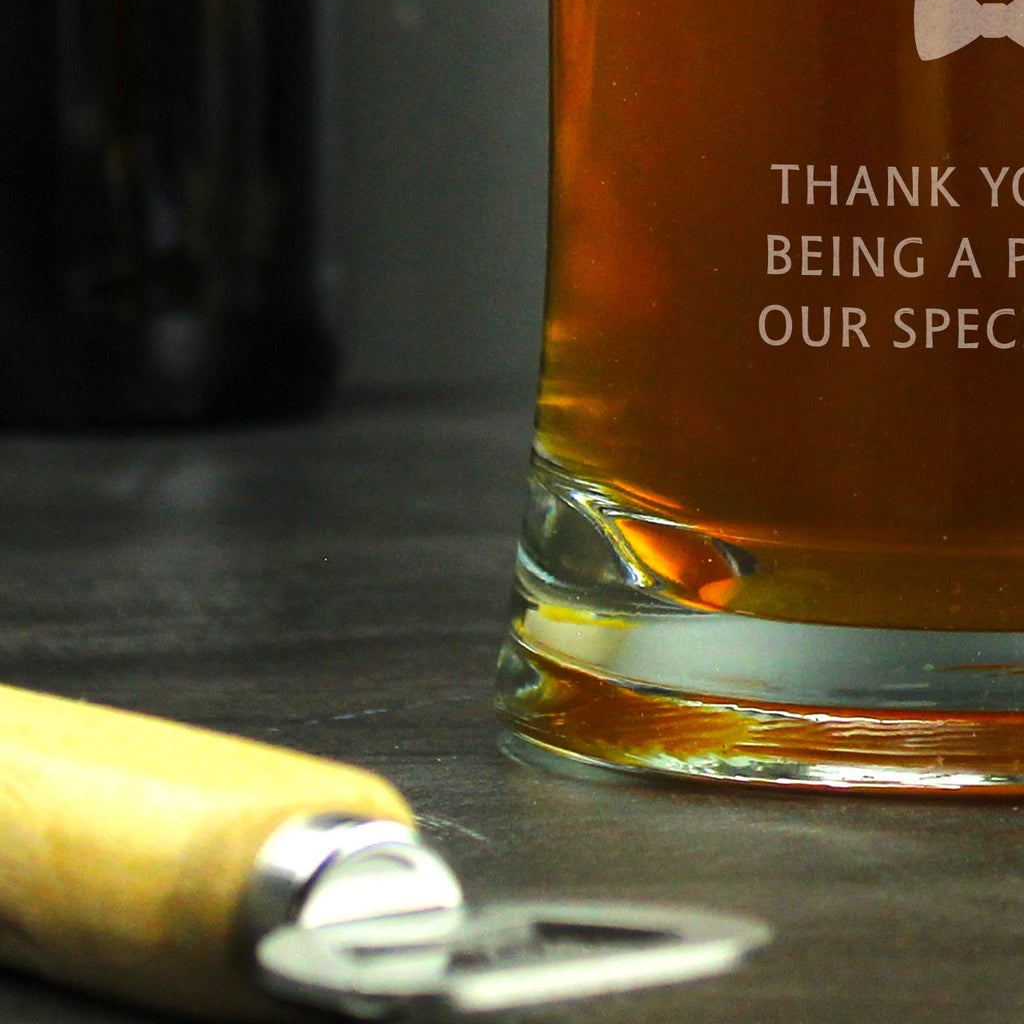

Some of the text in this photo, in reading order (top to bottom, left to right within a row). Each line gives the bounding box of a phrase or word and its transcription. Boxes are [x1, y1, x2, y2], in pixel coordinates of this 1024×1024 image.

[770, 163, 960, 207] THANK
[766, 234, 924, 278] BEING
[948, 237, 982, 278] A
[758, 304, 870, 348] OUR
